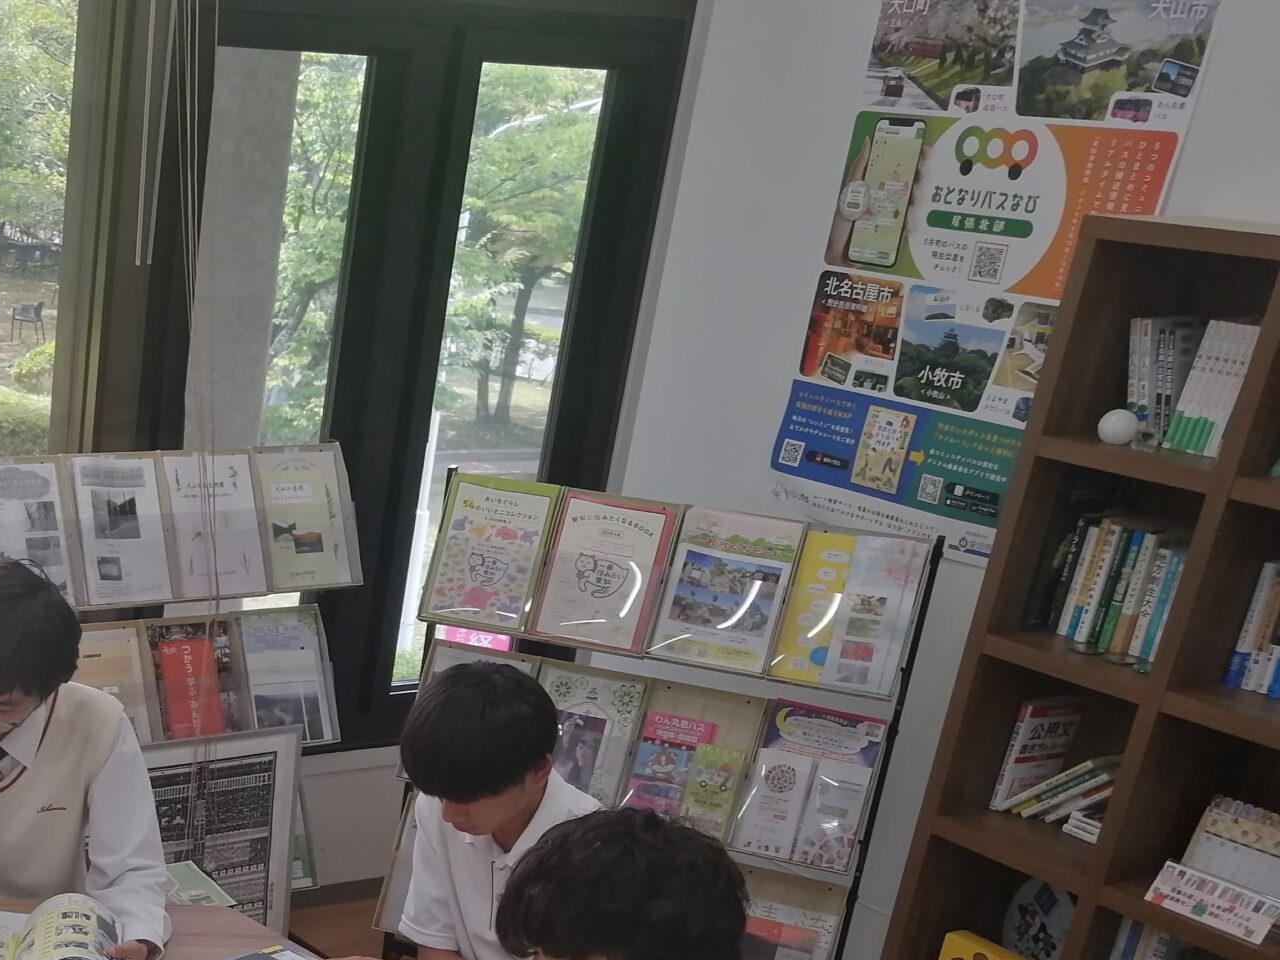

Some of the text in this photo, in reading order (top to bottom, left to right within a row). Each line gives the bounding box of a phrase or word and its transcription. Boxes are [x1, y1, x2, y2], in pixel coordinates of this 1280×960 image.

[1147, 0, 1209, 21] 犬山市
[931, 185, 1041, 214] おとなりバスなび
[950, 215, 1006, 233] 尾張北部
[824, 276, 894, 304] 北名古屋市
[918, 365, 965, 390] 小牧市
[1028, 720, 1075, 741] 公用文
